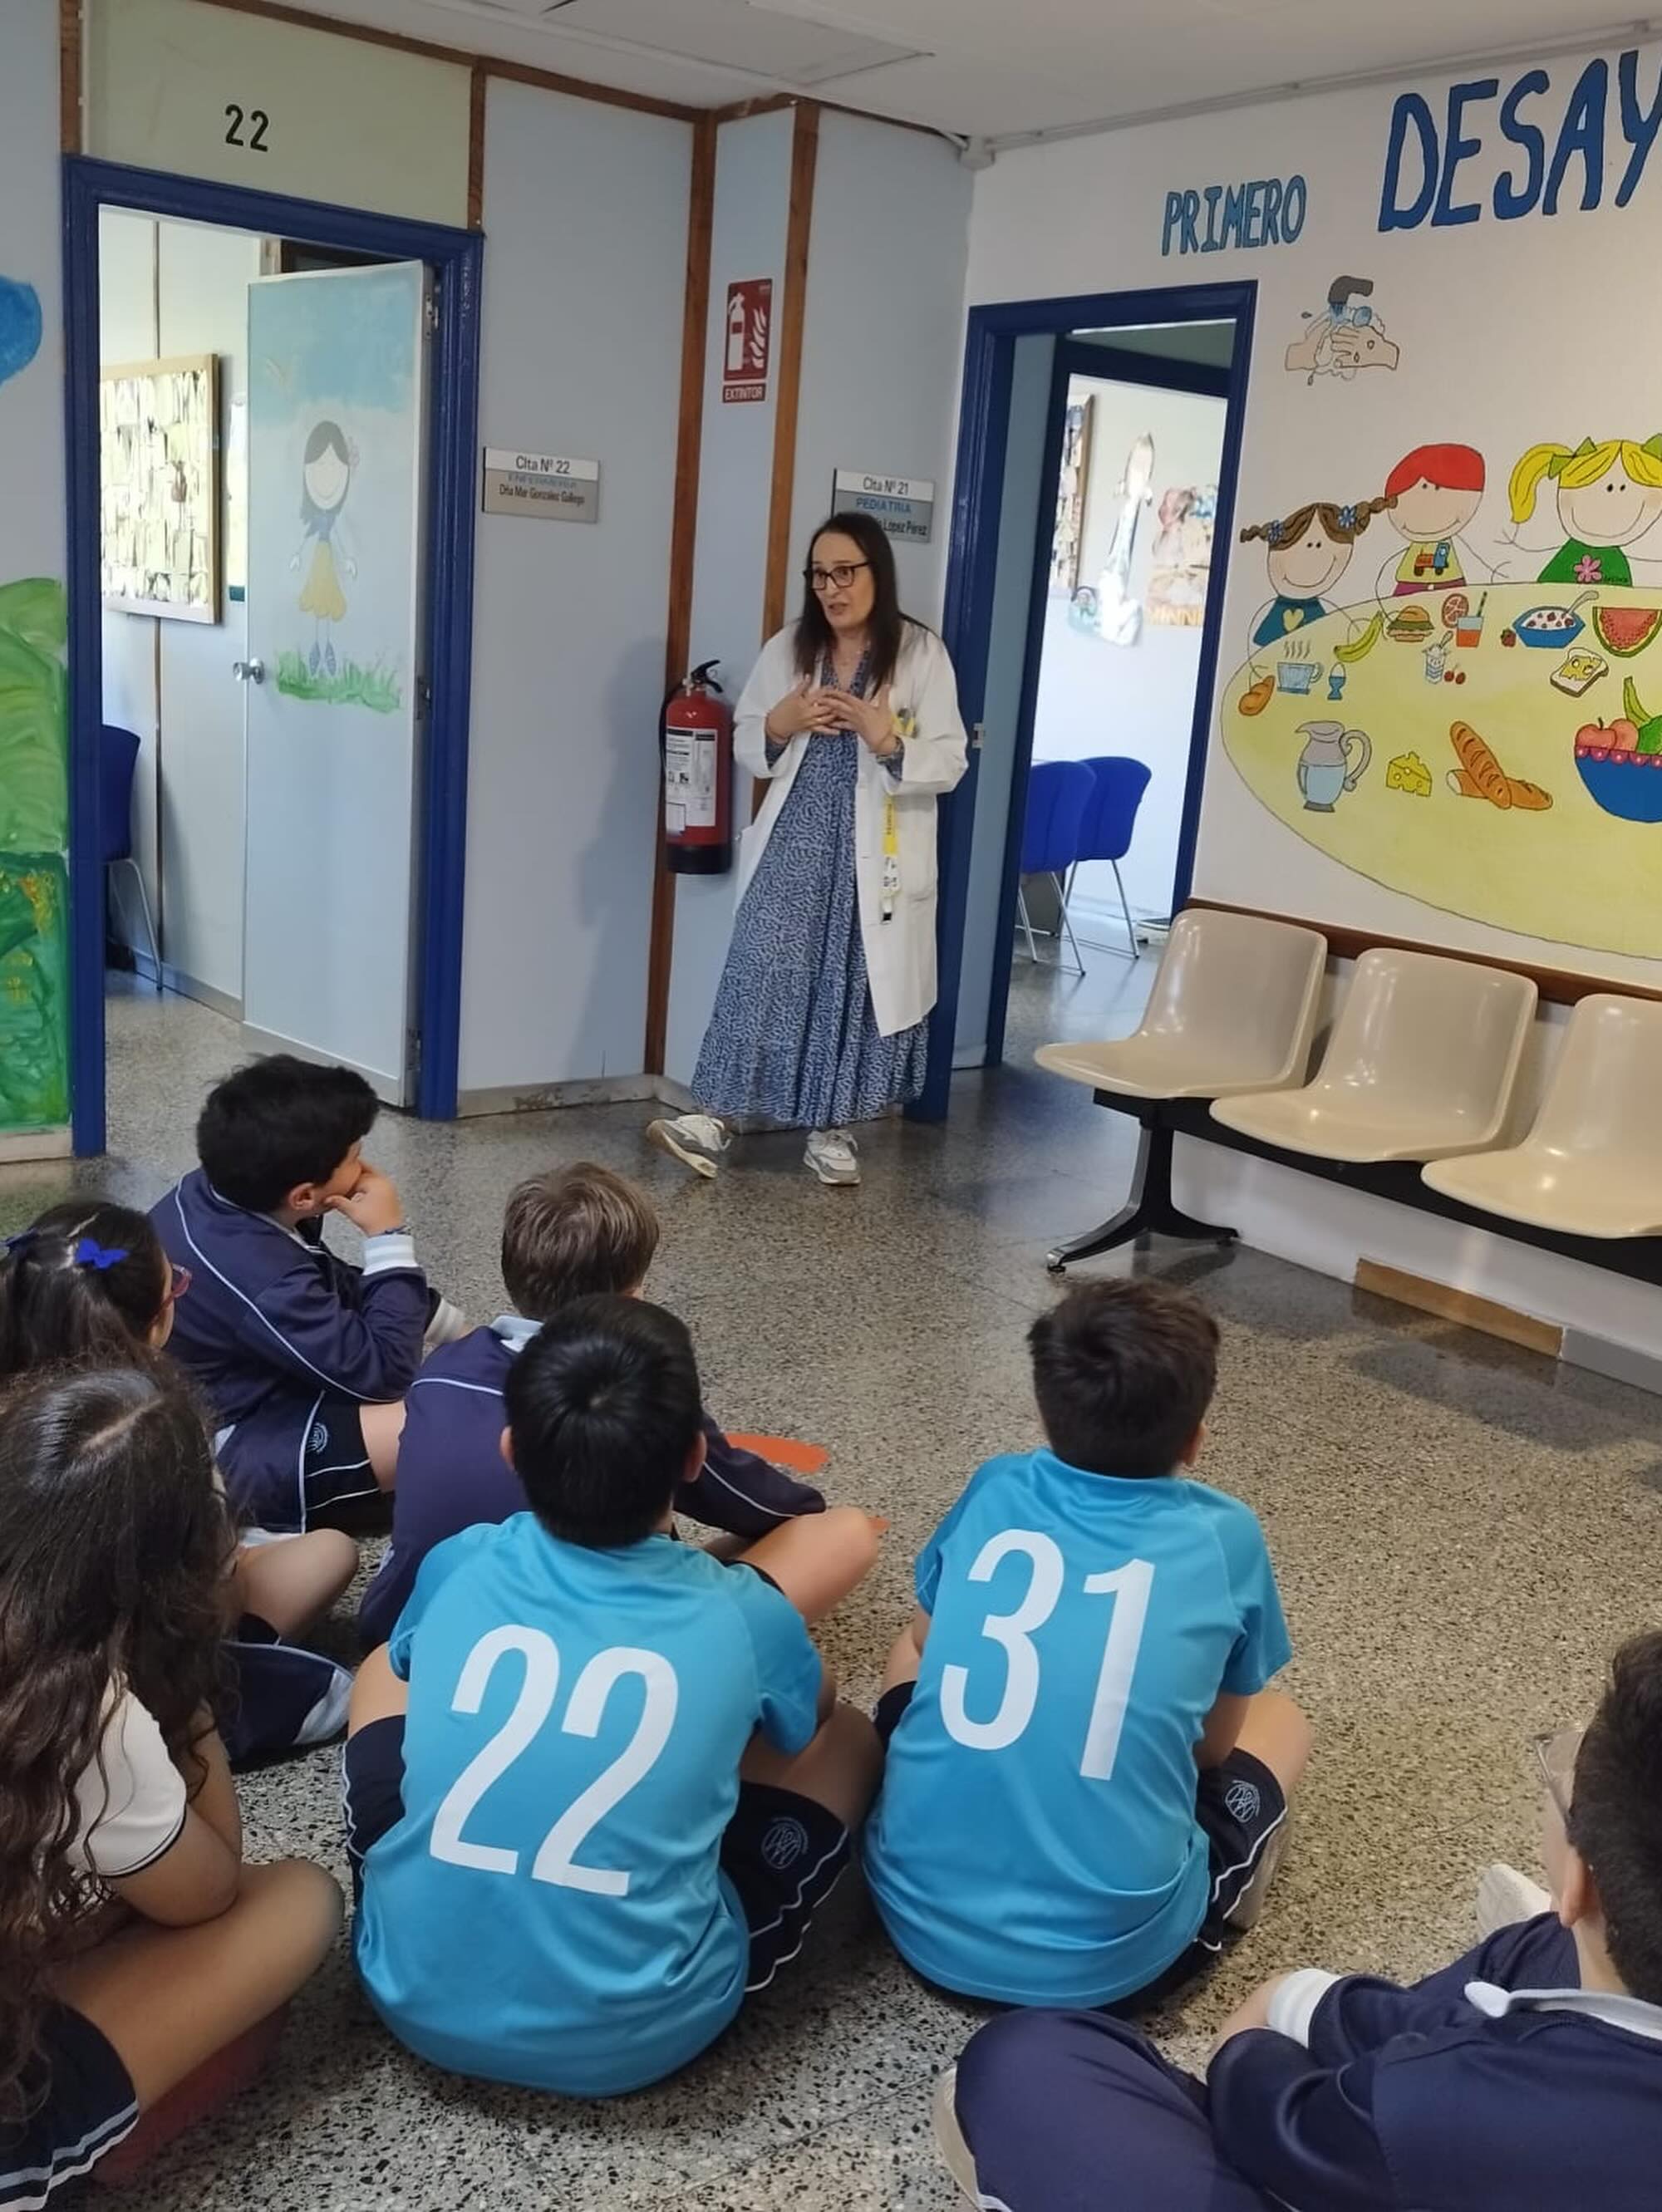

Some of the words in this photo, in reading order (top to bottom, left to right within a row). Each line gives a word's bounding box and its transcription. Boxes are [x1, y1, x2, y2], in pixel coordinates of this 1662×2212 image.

[224, 103, 270, 153] 22
[1378, 50, 1662, 232] DESAY
[1162, 175, 1308, 256] PRIMERO
[725, 386, 764, 401] EXTINTOR
[515, 455, 538, 471] Cita
[540, 458, 553, 473] Nº
[556, 460, 571, 474] 22
[863, 476, 883, 493] Cita
[897, 481, 909, 495] 21
[938, 1528, 1157, 1782] 31
[429, 1624, 680, 1900] 22
